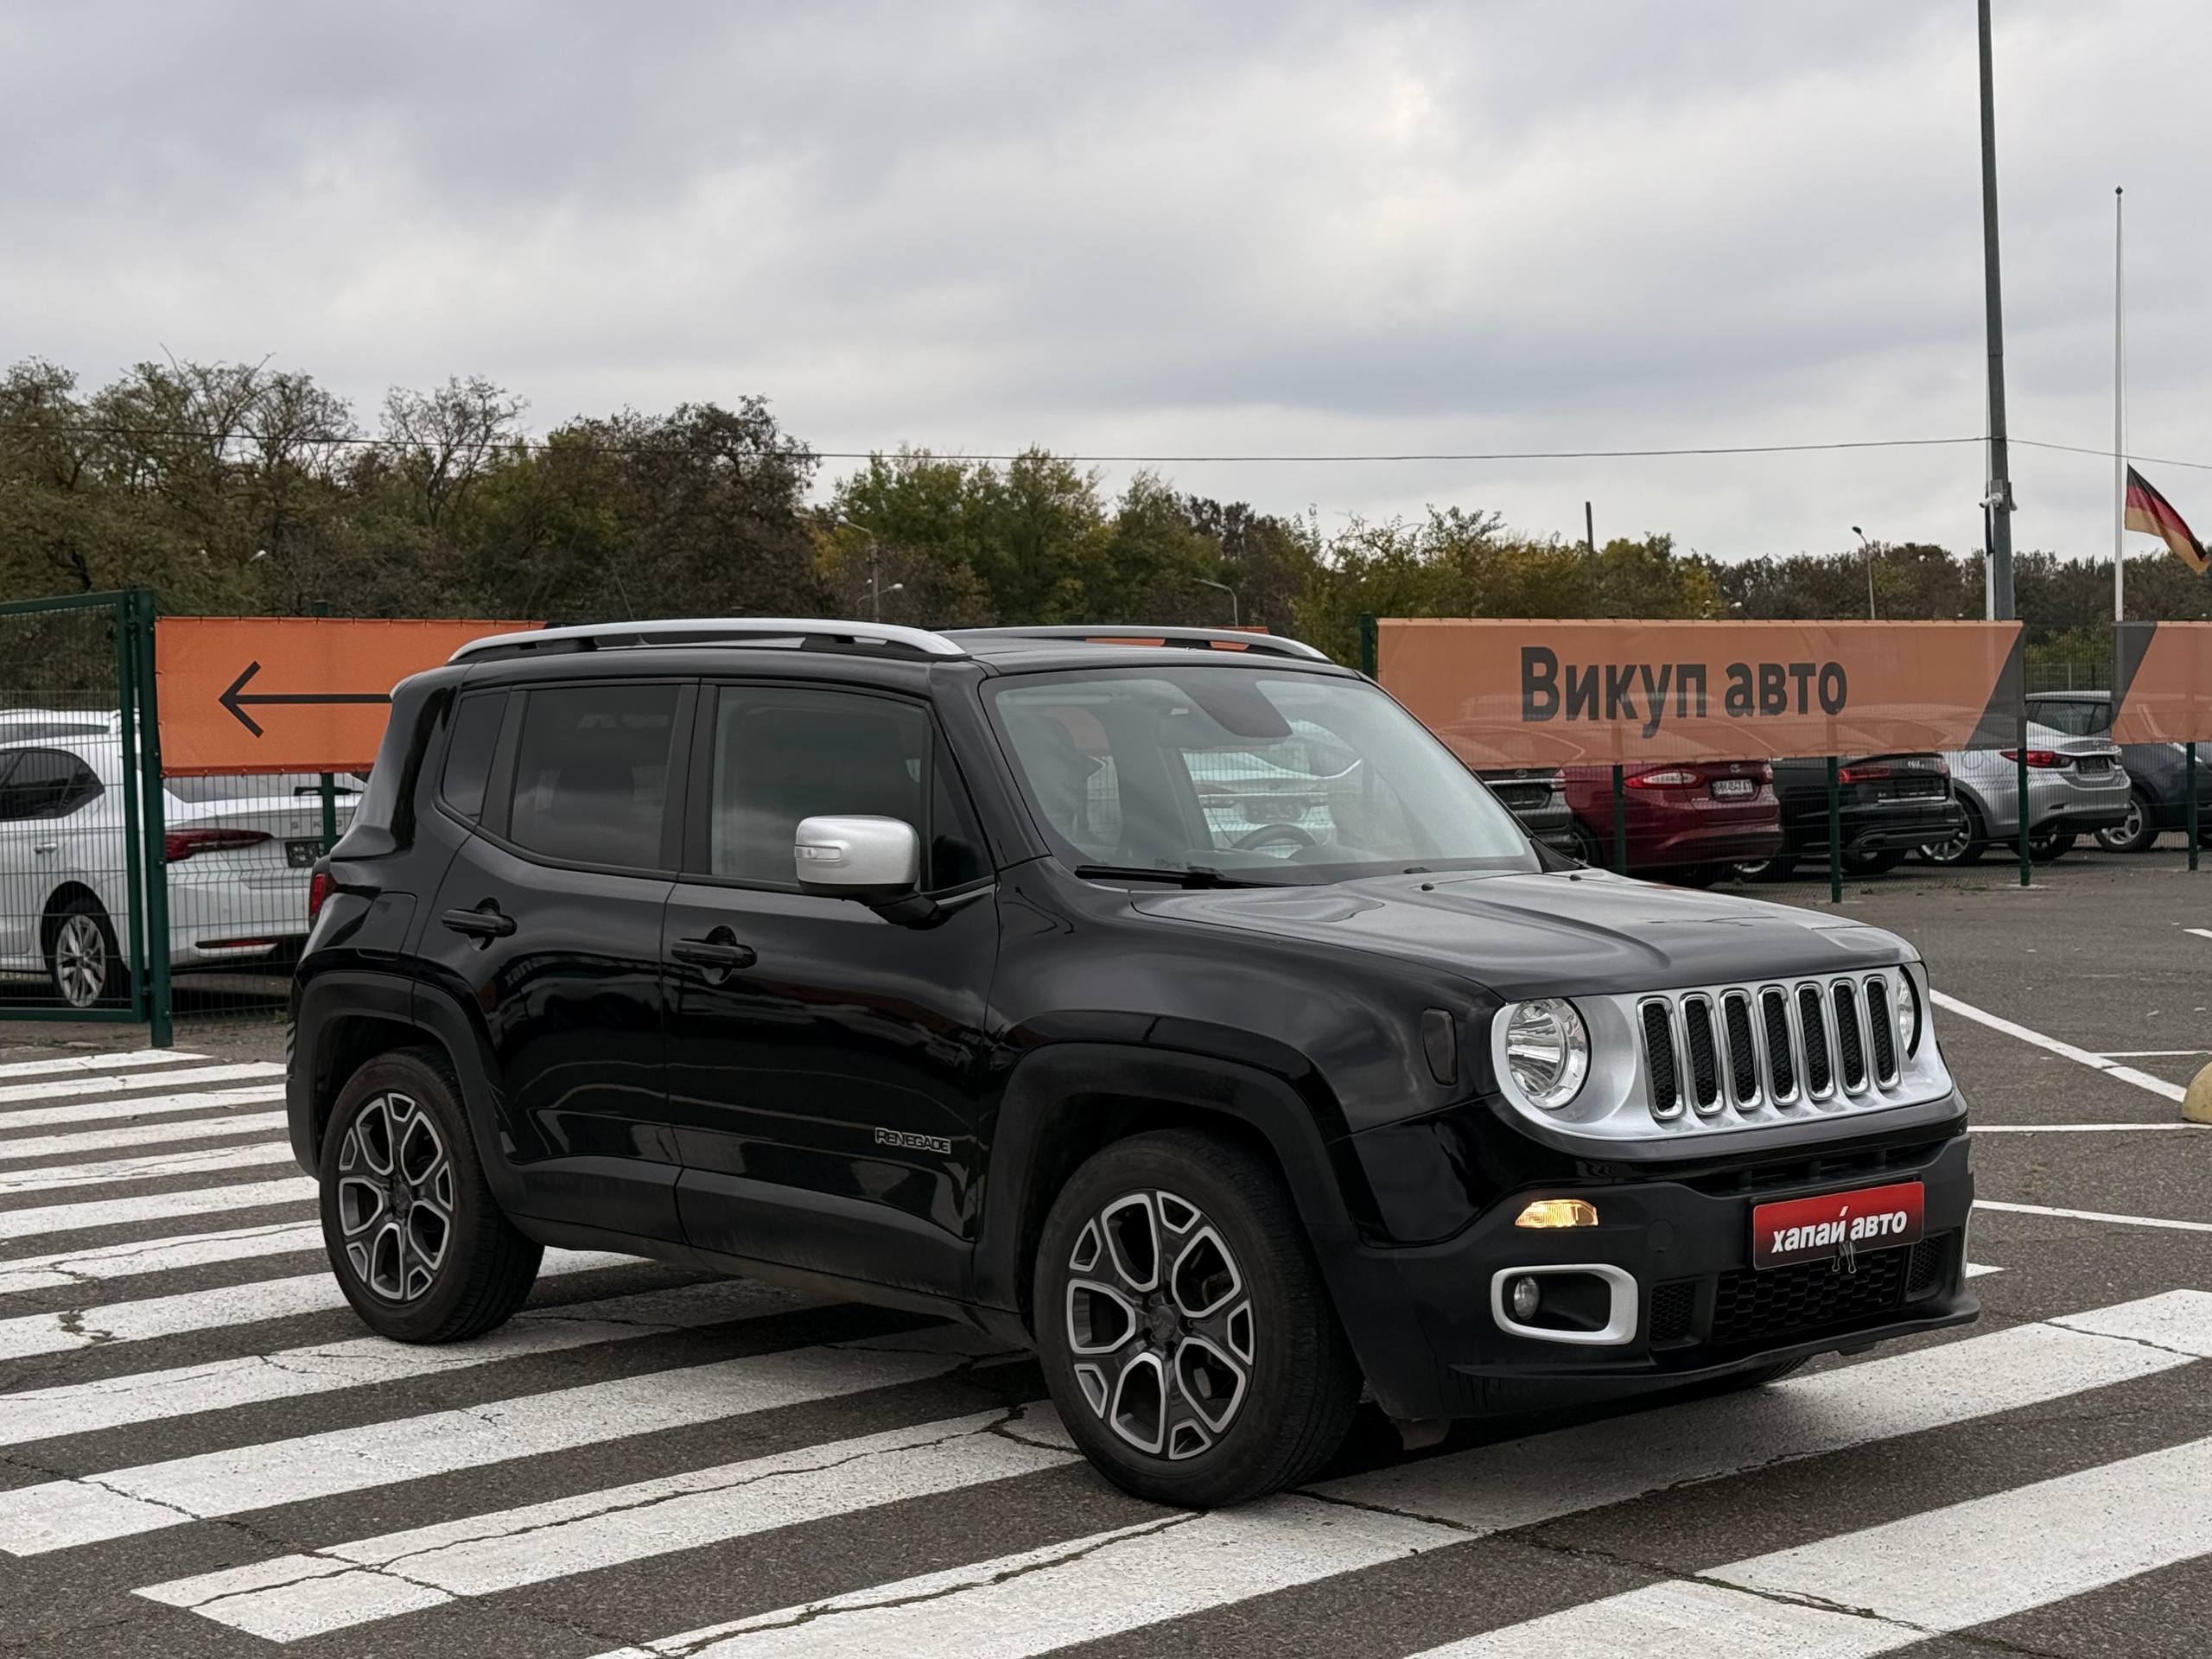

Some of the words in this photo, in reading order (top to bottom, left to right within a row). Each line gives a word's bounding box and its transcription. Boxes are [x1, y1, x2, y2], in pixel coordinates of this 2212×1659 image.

[1520, 645, 1707, 739] Викуп
[1724, 661, 1847, 716] авто
[874, 1127, 951, 1154] RENEGADE
[1850, 1211, 1908, 1241] авто
